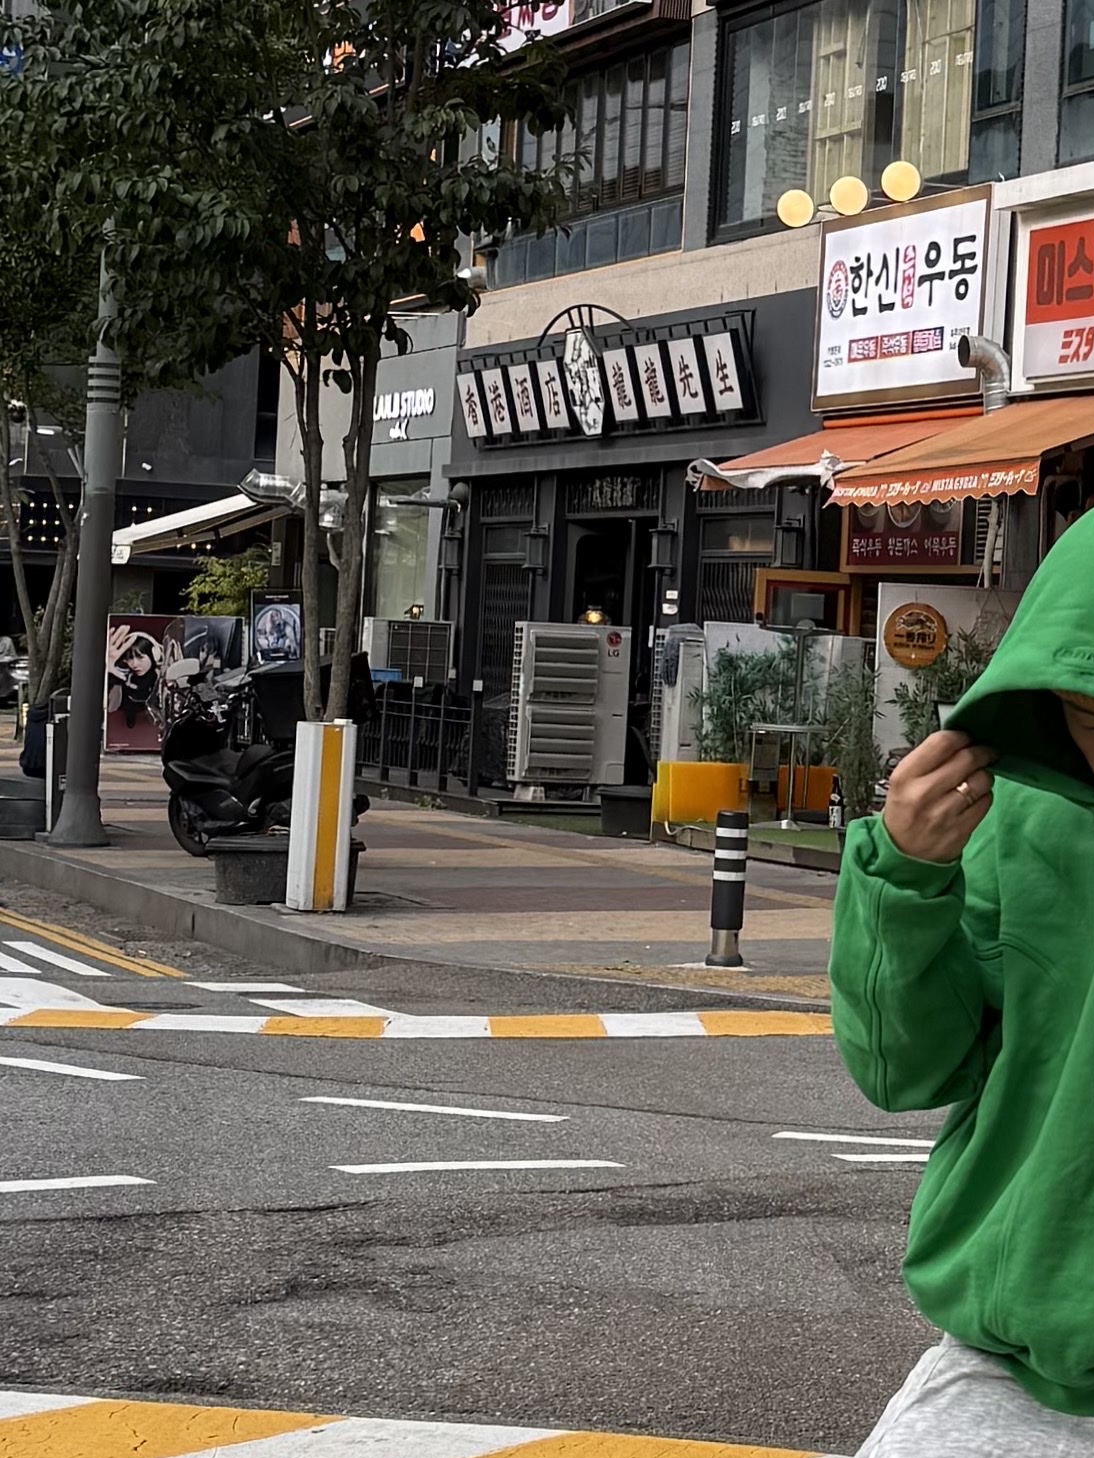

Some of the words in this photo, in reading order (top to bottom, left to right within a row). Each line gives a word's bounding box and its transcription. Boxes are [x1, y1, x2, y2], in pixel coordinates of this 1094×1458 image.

[849, 247, 900, 317] 한신
[918, 234, 978, 307] 우동
[400, 387, 434, 418] STUDIO
[465, 372, 562, 426] 香港酒店
[608, 649, 620, 657] LG
